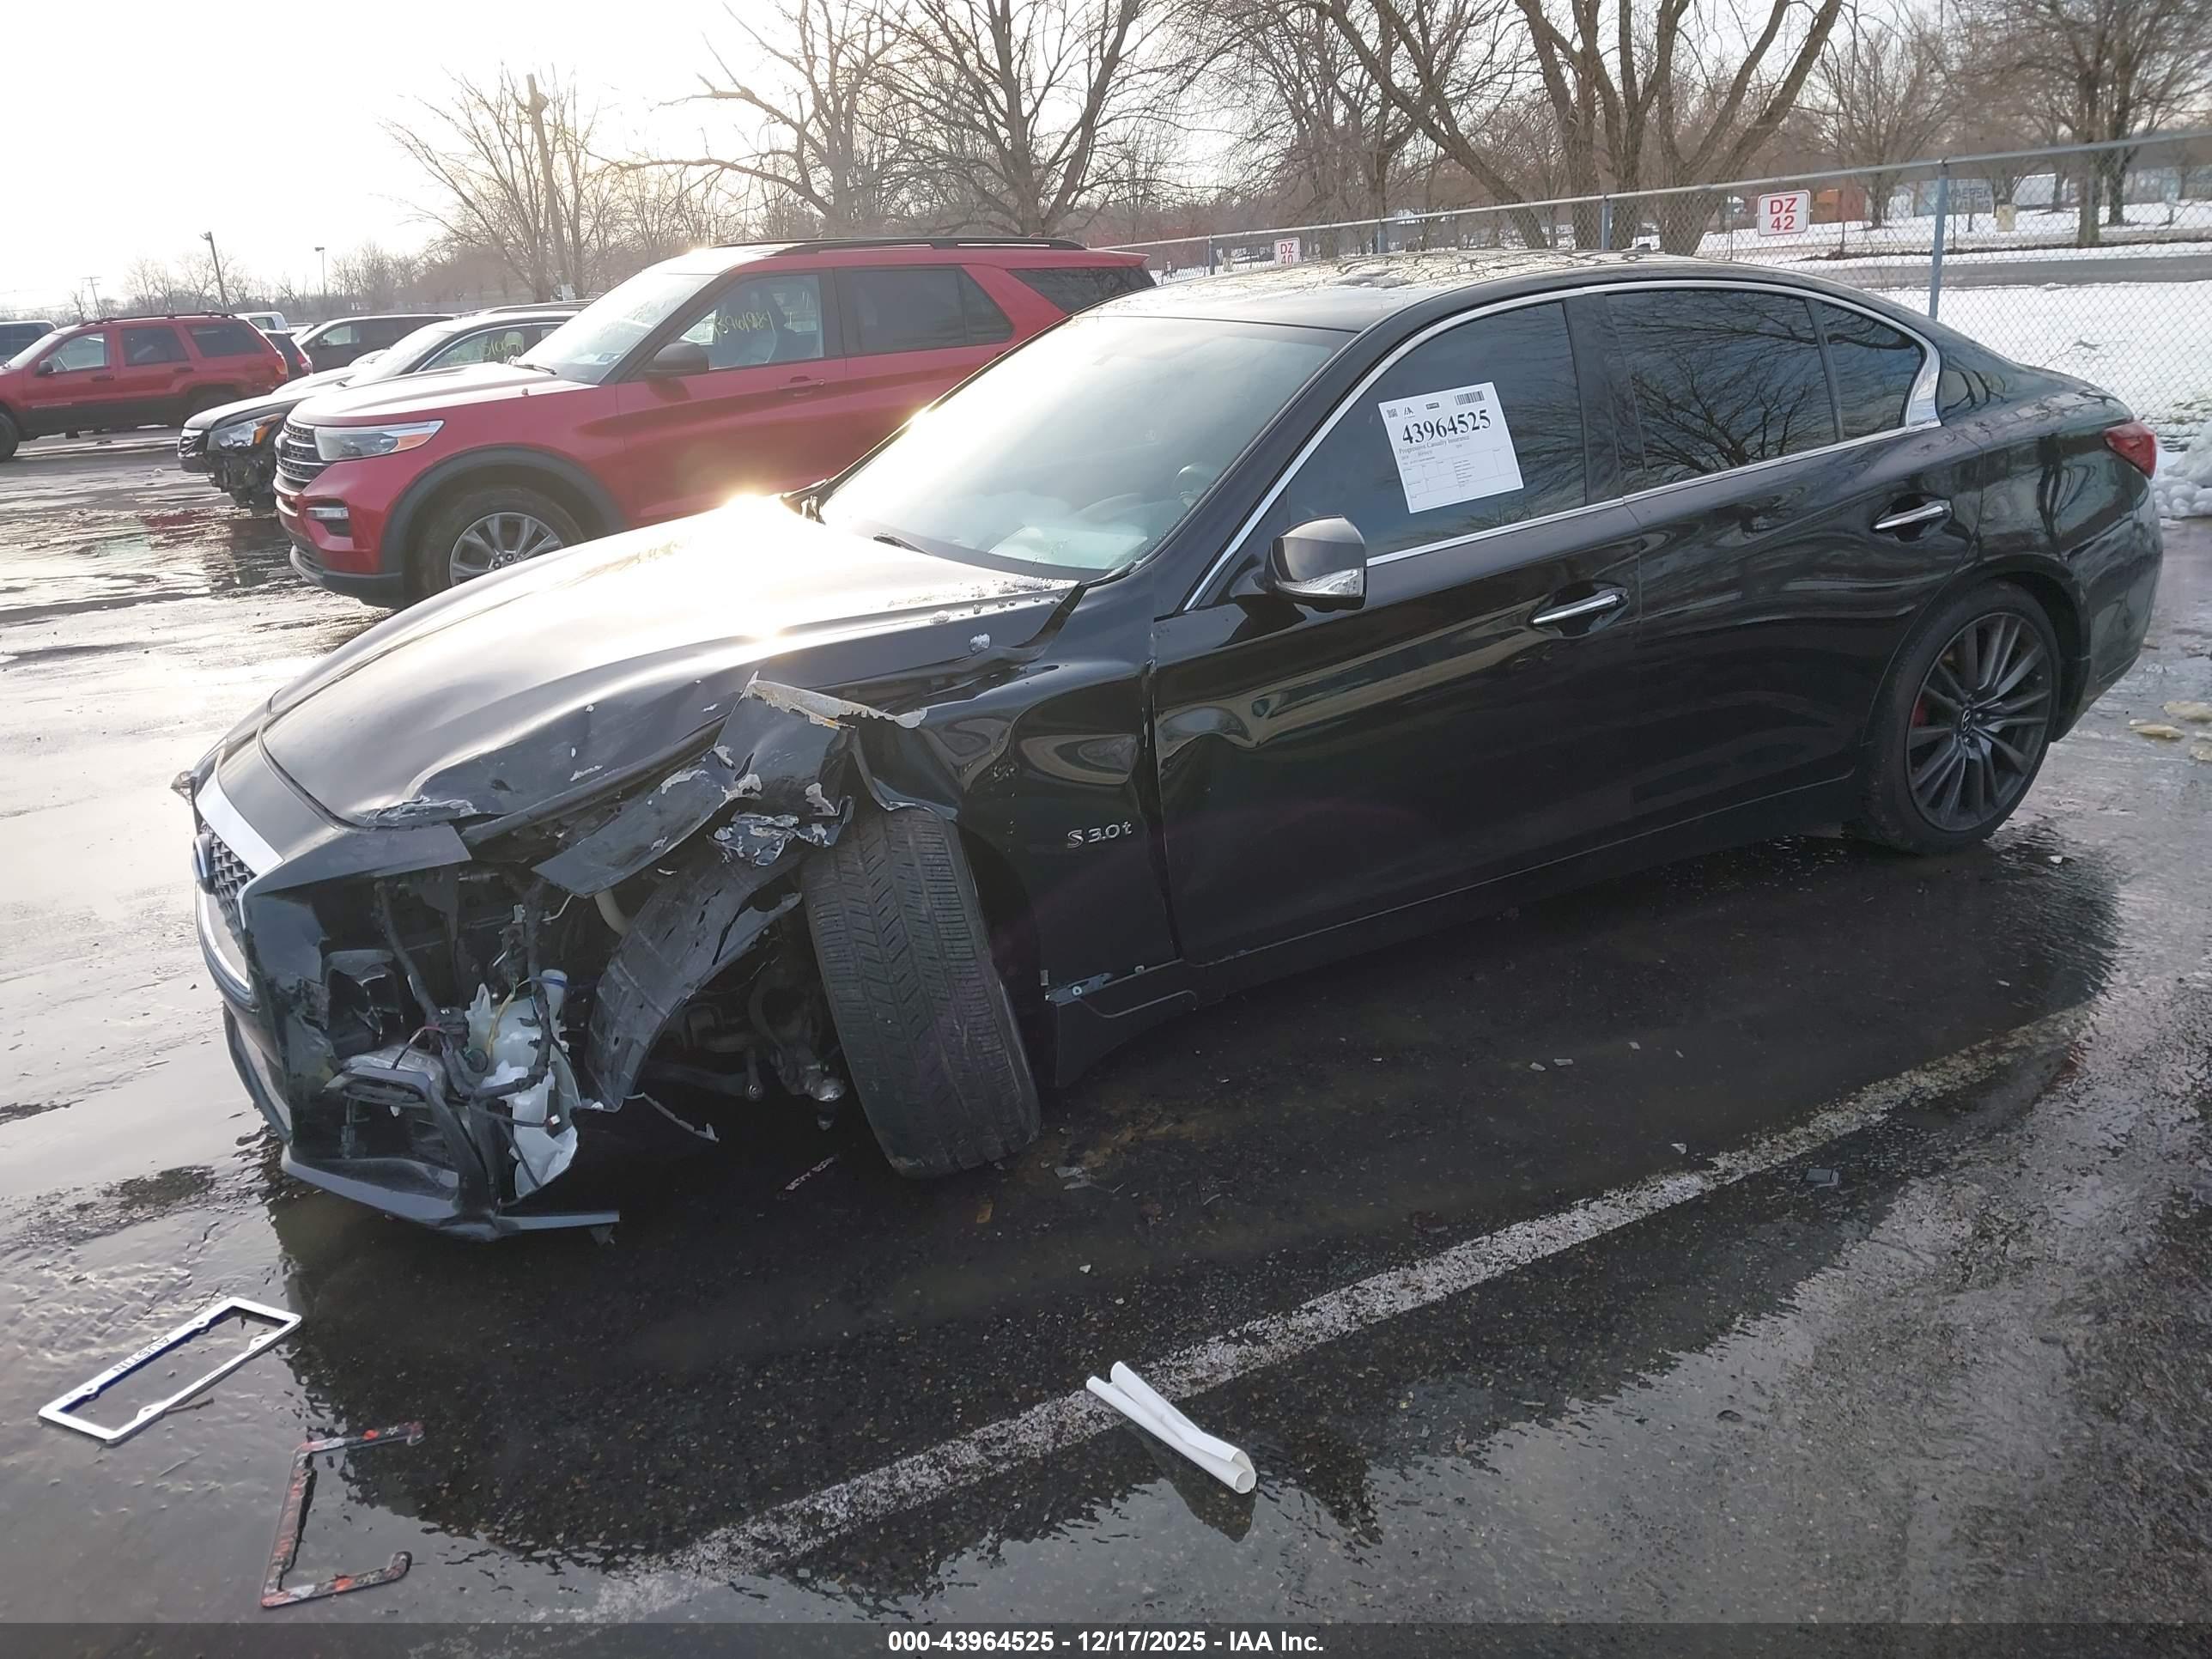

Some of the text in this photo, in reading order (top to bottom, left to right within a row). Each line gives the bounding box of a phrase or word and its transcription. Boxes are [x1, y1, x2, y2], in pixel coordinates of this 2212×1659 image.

[1770, 198, 1797, 215] DZ
[1771, 215, 1795, 231] 42
[1280, 243, 1294, 254] DZ
[1402, 409, 1492, 444] 43964525
[1067, 821, 1133, 848] S 3.0t
[112, 1337, 170, 1372] AUSTIN
